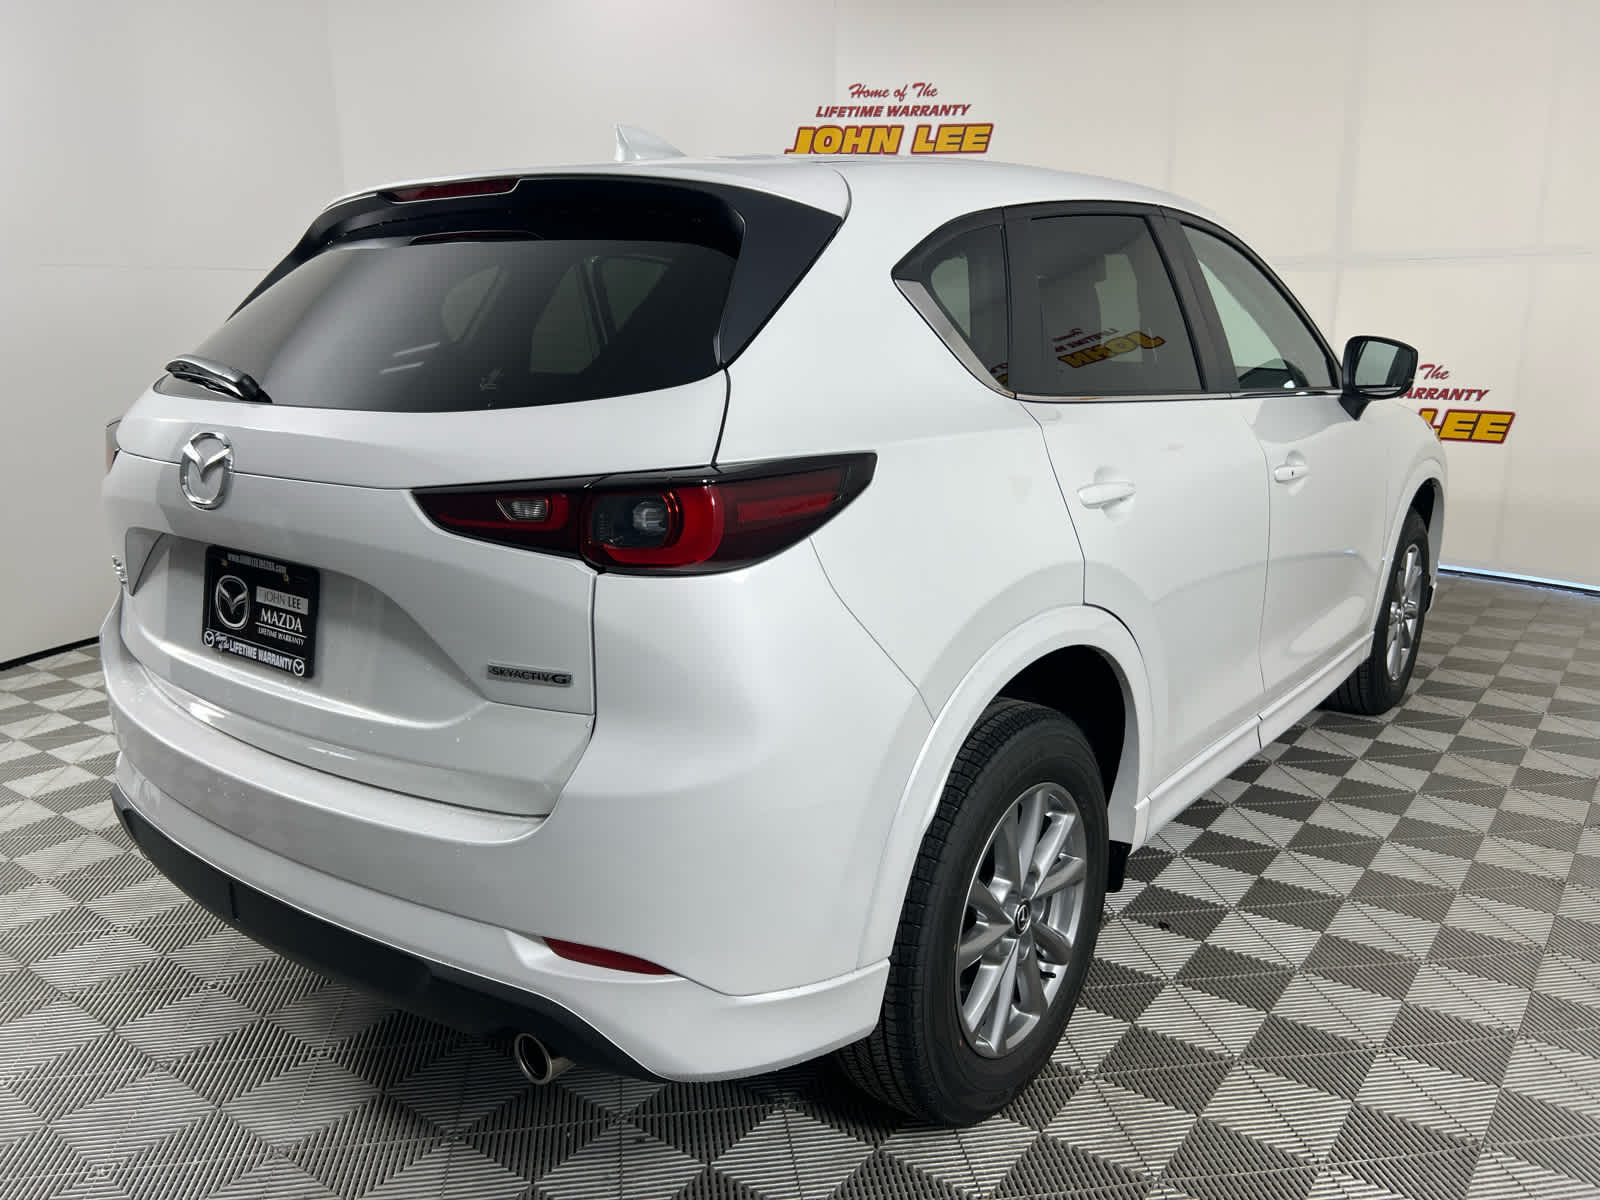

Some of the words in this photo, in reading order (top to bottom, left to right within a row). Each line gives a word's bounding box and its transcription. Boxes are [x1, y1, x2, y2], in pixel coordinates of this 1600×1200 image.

[848, 83, 889, 98] Home
[893, 84, 908, 101] of
[912, 82, 938, 98] The
[815, 106, 887, 117] LIFETIME
[886, 104, 971, 117] WARRANTY
[784, 124, 904, 155] JOHN
[910, 123, 994, 155] LEE
[1419, 364, 1449, 380] The
[1400, 387, 1489, 401] ARRANTY
[264, 590, 286, 606] JOHN
[287, 595, 302, 610] LEE
[260, 607, 303, 633] MAZDA
[229, 640, 257, 659] LIFETIME
[257, 649, 293, 671] WARRANTY
